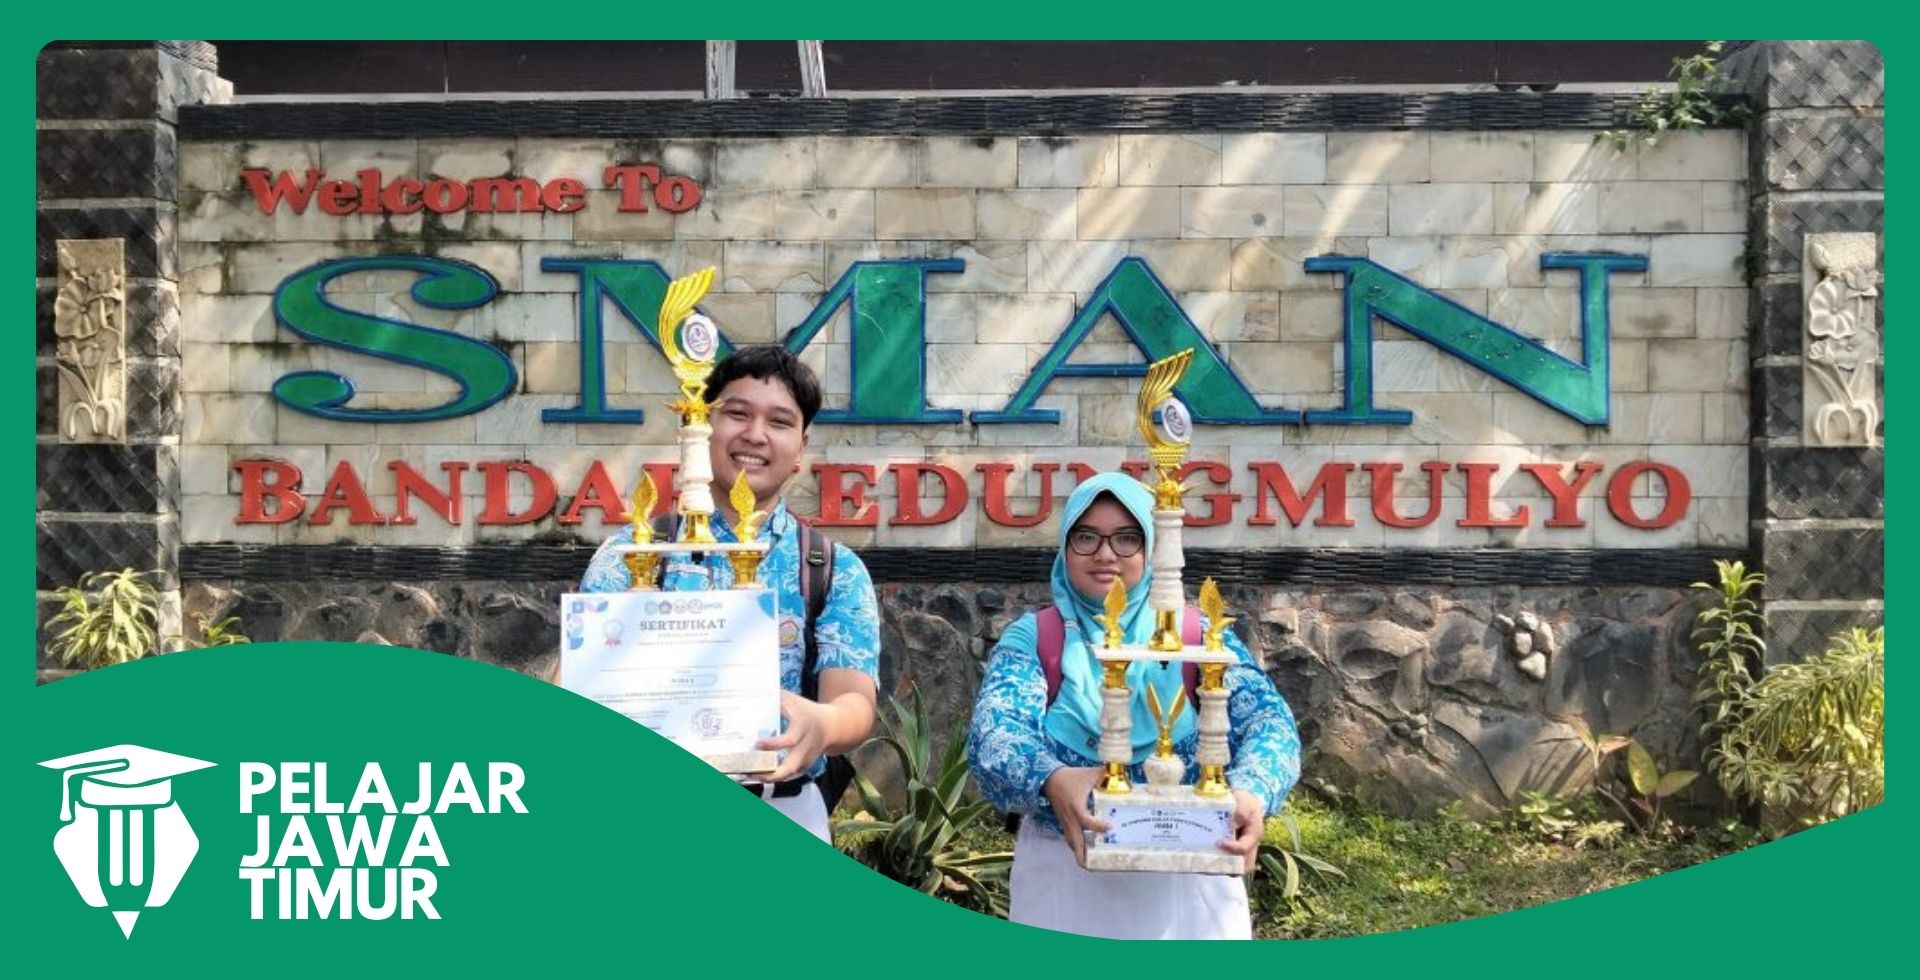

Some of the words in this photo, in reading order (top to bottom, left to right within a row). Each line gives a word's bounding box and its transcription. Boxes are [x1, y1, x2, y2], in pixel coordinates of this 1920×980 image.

[241, 168, 586, 216] Welcome
[605, 164, 702, 214] To
[271, 254, 1649, 428] SMAN
[793, 460, 1693, 530] EDUGMULYO
[639, 618, 727, 632] SERTIFIKAT
